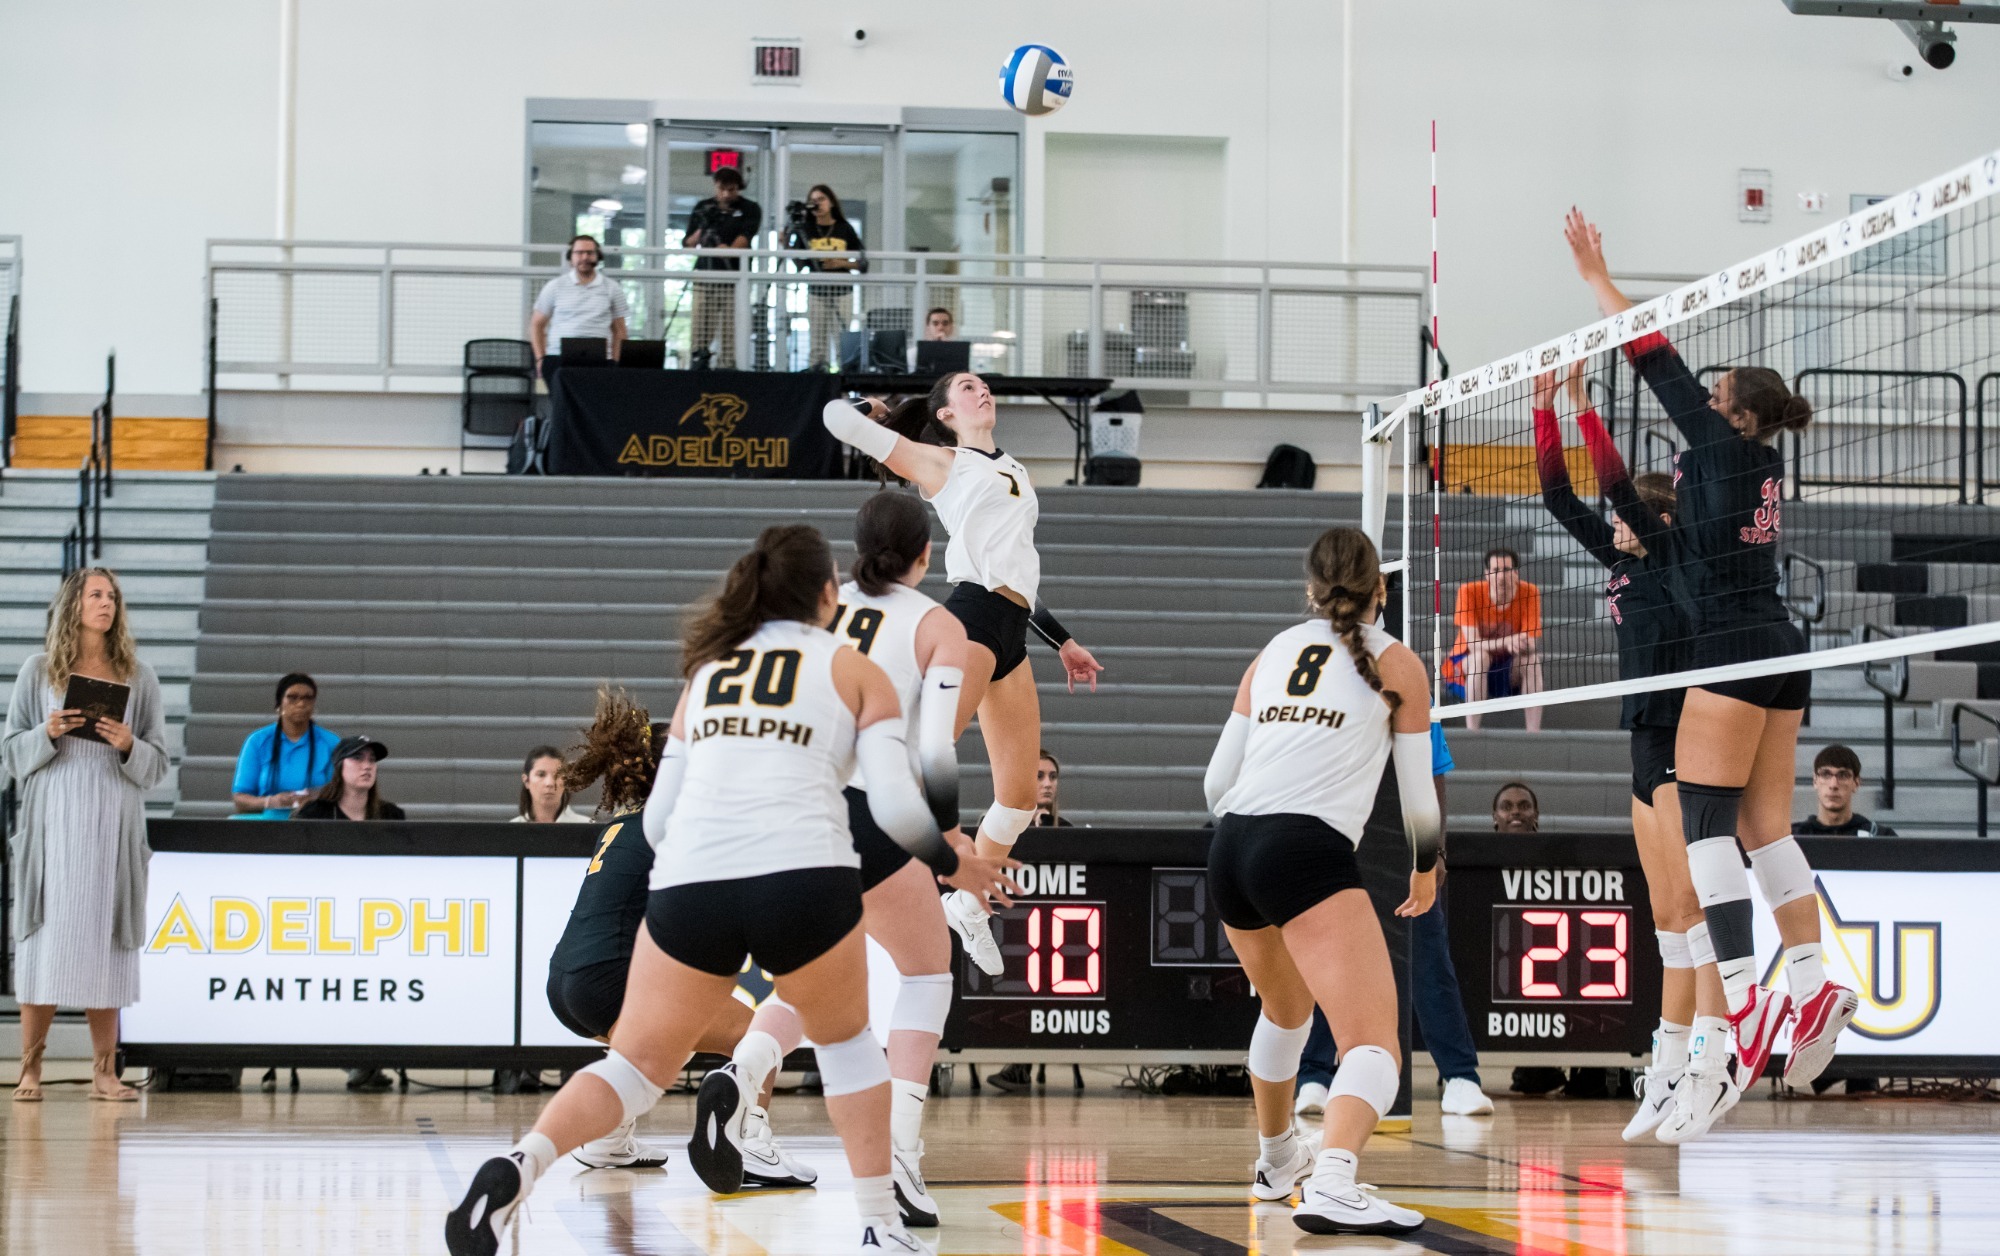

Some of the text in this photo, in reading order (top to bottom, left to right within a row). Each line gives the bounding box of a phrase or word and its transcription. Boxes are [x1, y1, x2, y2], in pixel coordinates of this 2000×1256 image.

[617, 432, 789, 468] ADELPHI
[704, 649, 803, 708] 20
[1286, 644, 1333, 697] 8
[1501, 869, 1625, 901] VISITOR
[144, 892, 490, 957] ADELPHI
[1027, 907, 1101, 994] 10
[1521, 911, 1627, 998] 23
[208, 977, 425, 1002] PANTHERS
[1030, 1009, 1111, 1034] BONUS
[1488, 1012, 1566, 1038] BONUS
